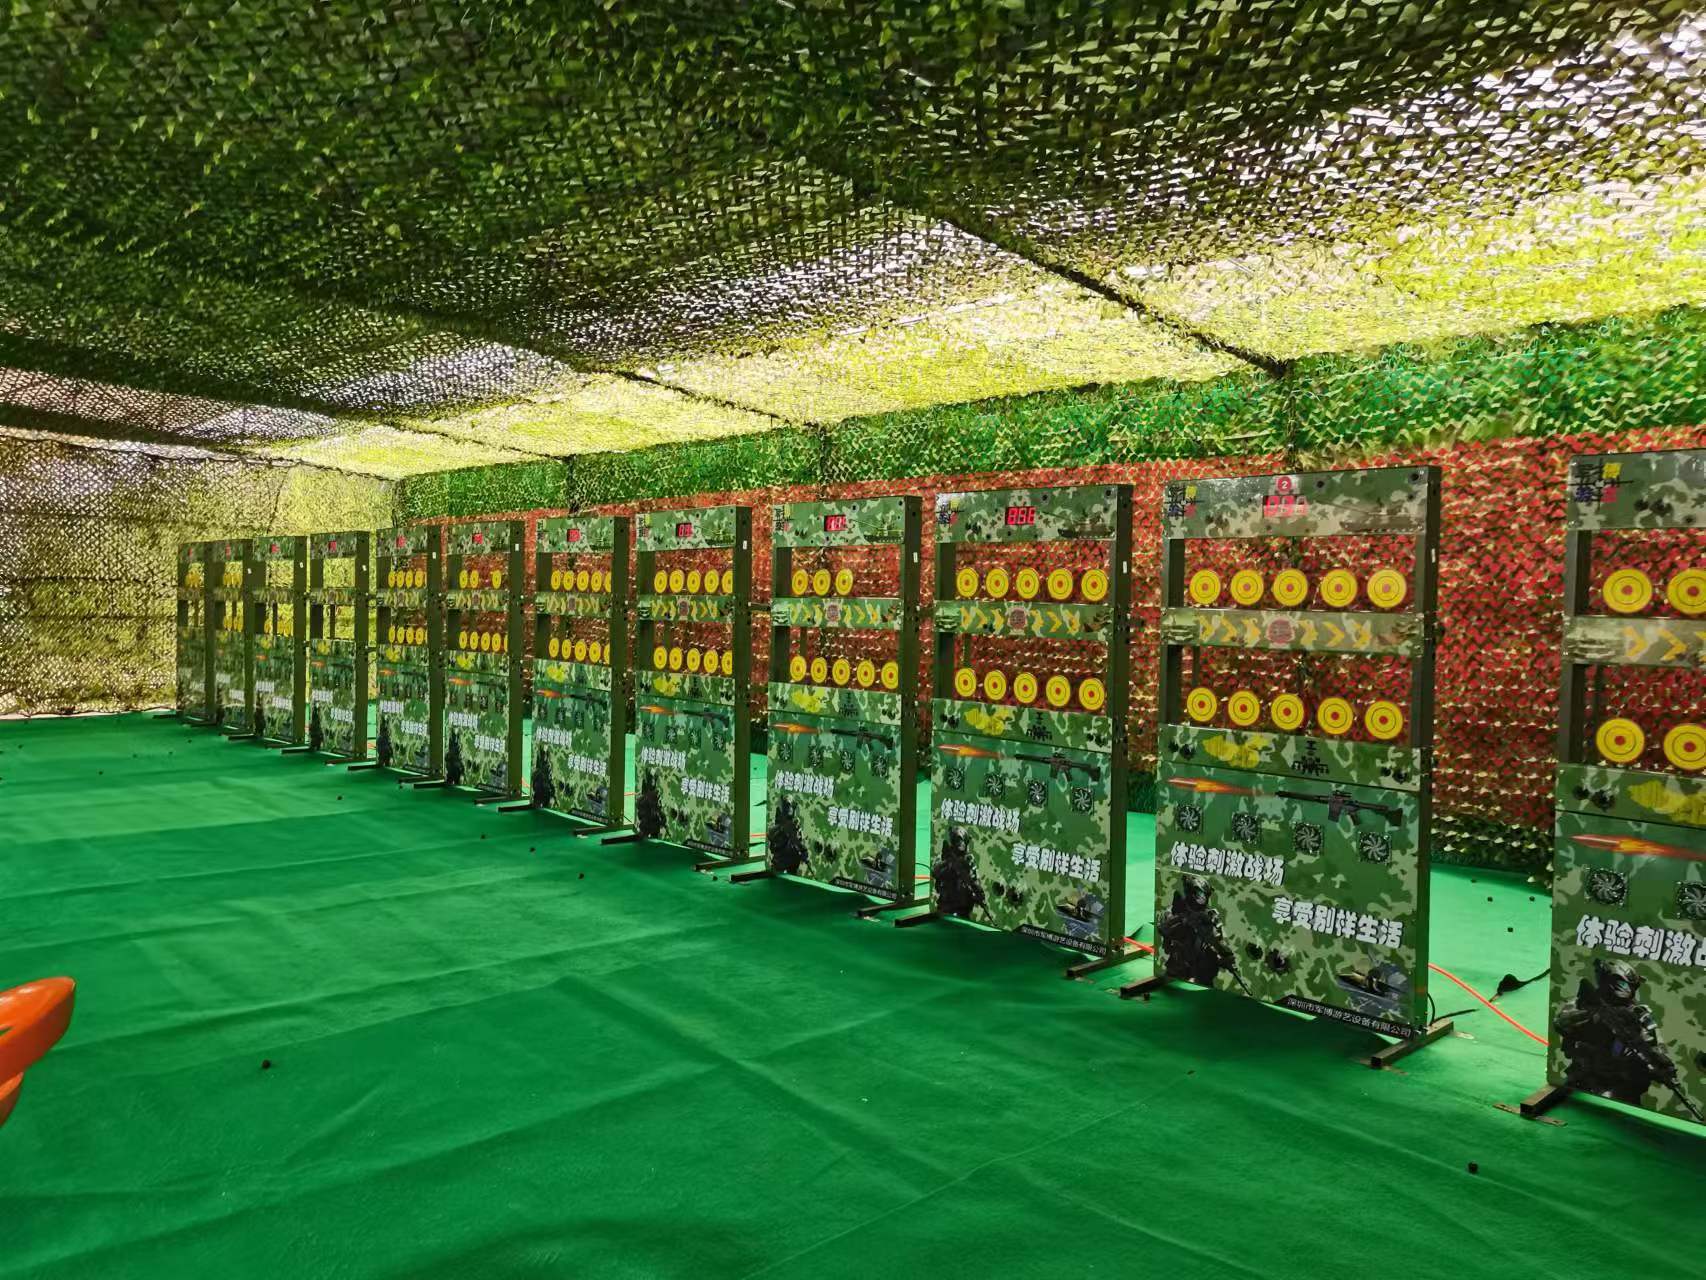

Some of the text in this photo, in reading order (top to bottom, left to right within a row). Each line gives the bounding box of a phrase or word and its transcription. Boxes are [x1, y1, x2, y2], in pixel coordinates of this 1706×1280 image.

[1281, 480, 1288, 489] 2
[940, 798, 1021, 833] 体验刺激战场
[1011, 843, 1102, 883] 享受别样生活
[1171, 841, 1285, 886] 体验刺激战场
[1271, 896, 1403, 948] 享受别样生活
